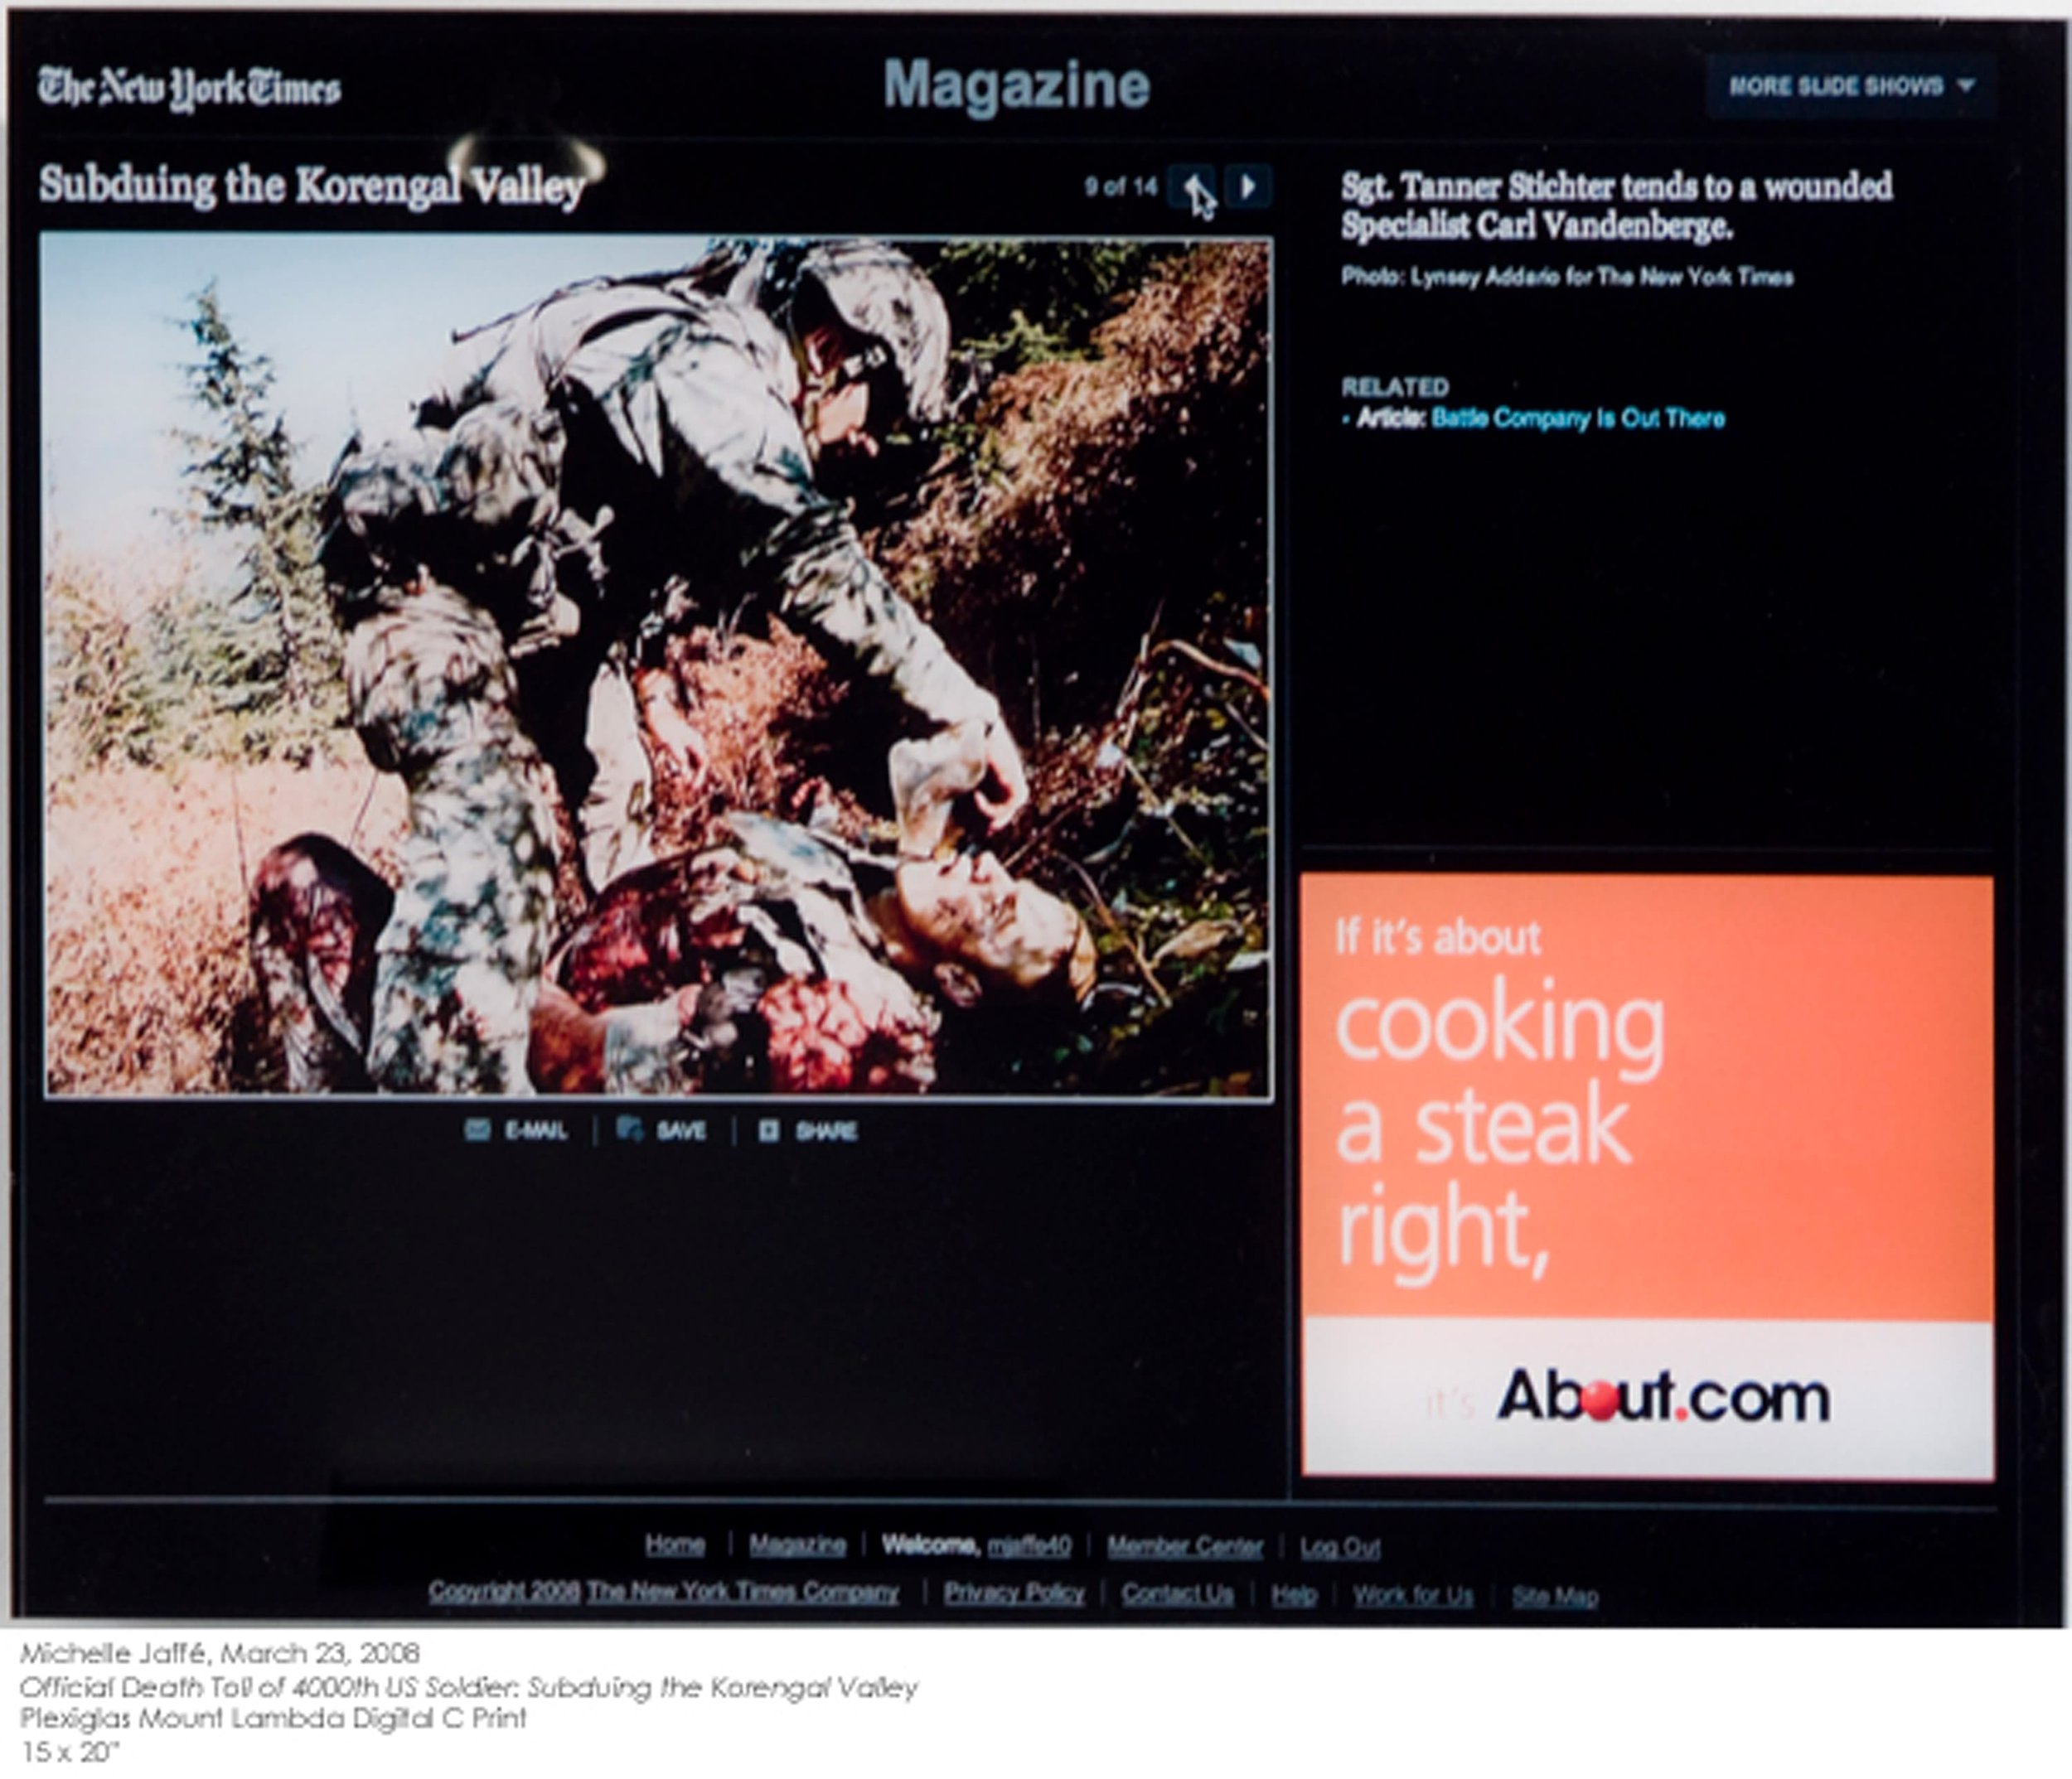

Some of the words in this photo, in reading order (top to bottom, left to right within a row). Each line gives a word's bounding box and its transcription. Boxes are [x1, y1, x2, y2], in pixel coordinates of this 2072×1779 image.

[37, 65, 97, 107] The
[98, 66, 165, 105] New
[168, 66, 246, 114] York
[247, 66, 342, 106] Times
[884, 57, 1151, 121] Magazine
[1730, 75, 1793, 97] MORE
[1798, 75, 1860, 97] SLIDE
[1865, 75, 1944, 97] SHOWS
[39, 161, 218, 213] Subduing
[225, 162, 287, 204] the
[295, 164, 462, 214] Korengal
[474, 166, 587, 213] Valley
[1084, 176, 1099, 196] 9
[1103, 176, 1127, 197] of
[1133, 176, 1159, 196] 14
[1341, 170, 1394, 206] Sgt.
[1399, 170, 1503, 201] Tanner
[1508, 168, 1617, 202] Stichter
[1621, 169, 1700, 202] tends
[1703, 173, 1734, 202] to
[1739, 177, 1758, 201] a
[1764, 168, 1895, 202] wounded
[1341, 207, 1472, 246] Specialist
[1476, 207, 1537, 241] Carl
[1542, 207, 1735, 247] Vandenberge.
[1341, 264, 1405, 287] Photo:
[1410, 265, 1482, 291] Lynsey
[1484, 265, 1561, 288] Addario
[1565, 264, 1594, 288] for
[1597, 264, 1635, 288] The
[1639, 265, 1684, 288] New
[1687, 265, 1733, 288] York
[1737, 264, 1795, 288] Times
[1341, 375, 1450, 399] RELATED
[1356, 404, 1427, 430] Article:
[1431, 404, 1490, 429] Battle
[1493, 404, 1592, 433] Company
[1597, 406, 1616, 429] Is
[1620, 404, 1661, 429] Out
[1664, 405, 1726, 430] There
[1336, 915, 1362, 956] If
[1433, 916, 1542, 956] about
[1335, 973, 1665, 1084] cooking
[505, 1119, 568, 1141] E-MAIL
[656, 1120, 706, 1141] SAVE
[796, 1120, 858, 1142] SHARE
[1336, 1100, 1382, 1164] a
[1416, 1076, 1634, 1165] steak
[1340, 1178, 1550, 1290] right,
[1496, 1367, 1831, 1423] About.com
[646, 1534, 706, 1559] Home
[749, 1534, 847, 1559] Magazine
[881, 1533, 982, 1558] Welcome,
[1107, 1535, 1188, 1560] Member
[1194, 1535, 1265, 1561] Center
[1300, 1536, 1338, 1561] Log
[1343, 1536, 1382, 1561] Out
[428, 1580, 525, 1606] Copyright
[530, 1580, 581, 1606] 2008
[586, 1580, 627, 1606] The
[632, 1580, 678, 1606] New
[681, 1580, 728, 1606] York
[735, 1580, 796, 1606] Times
[801, 1580, 900, 1607] Company
[944, 1581, 1019, 1607] Privacy
[1025, 1581, 1086, 1607] Policy
[1121, 1582, 1201, 1608] Contact
[1206, 1583, 1236, 1608] Us
[1271, 1583, 1319, 1609] Help
[1353, 1584, 1406, 1610] Work
[1412, 1584, 1440, 1610] for
[1446, 1584, 1474, 1610] Us
[1512, 1584, 1550, 1611] Site
[1555, 1585, 1600, 1611] Map
